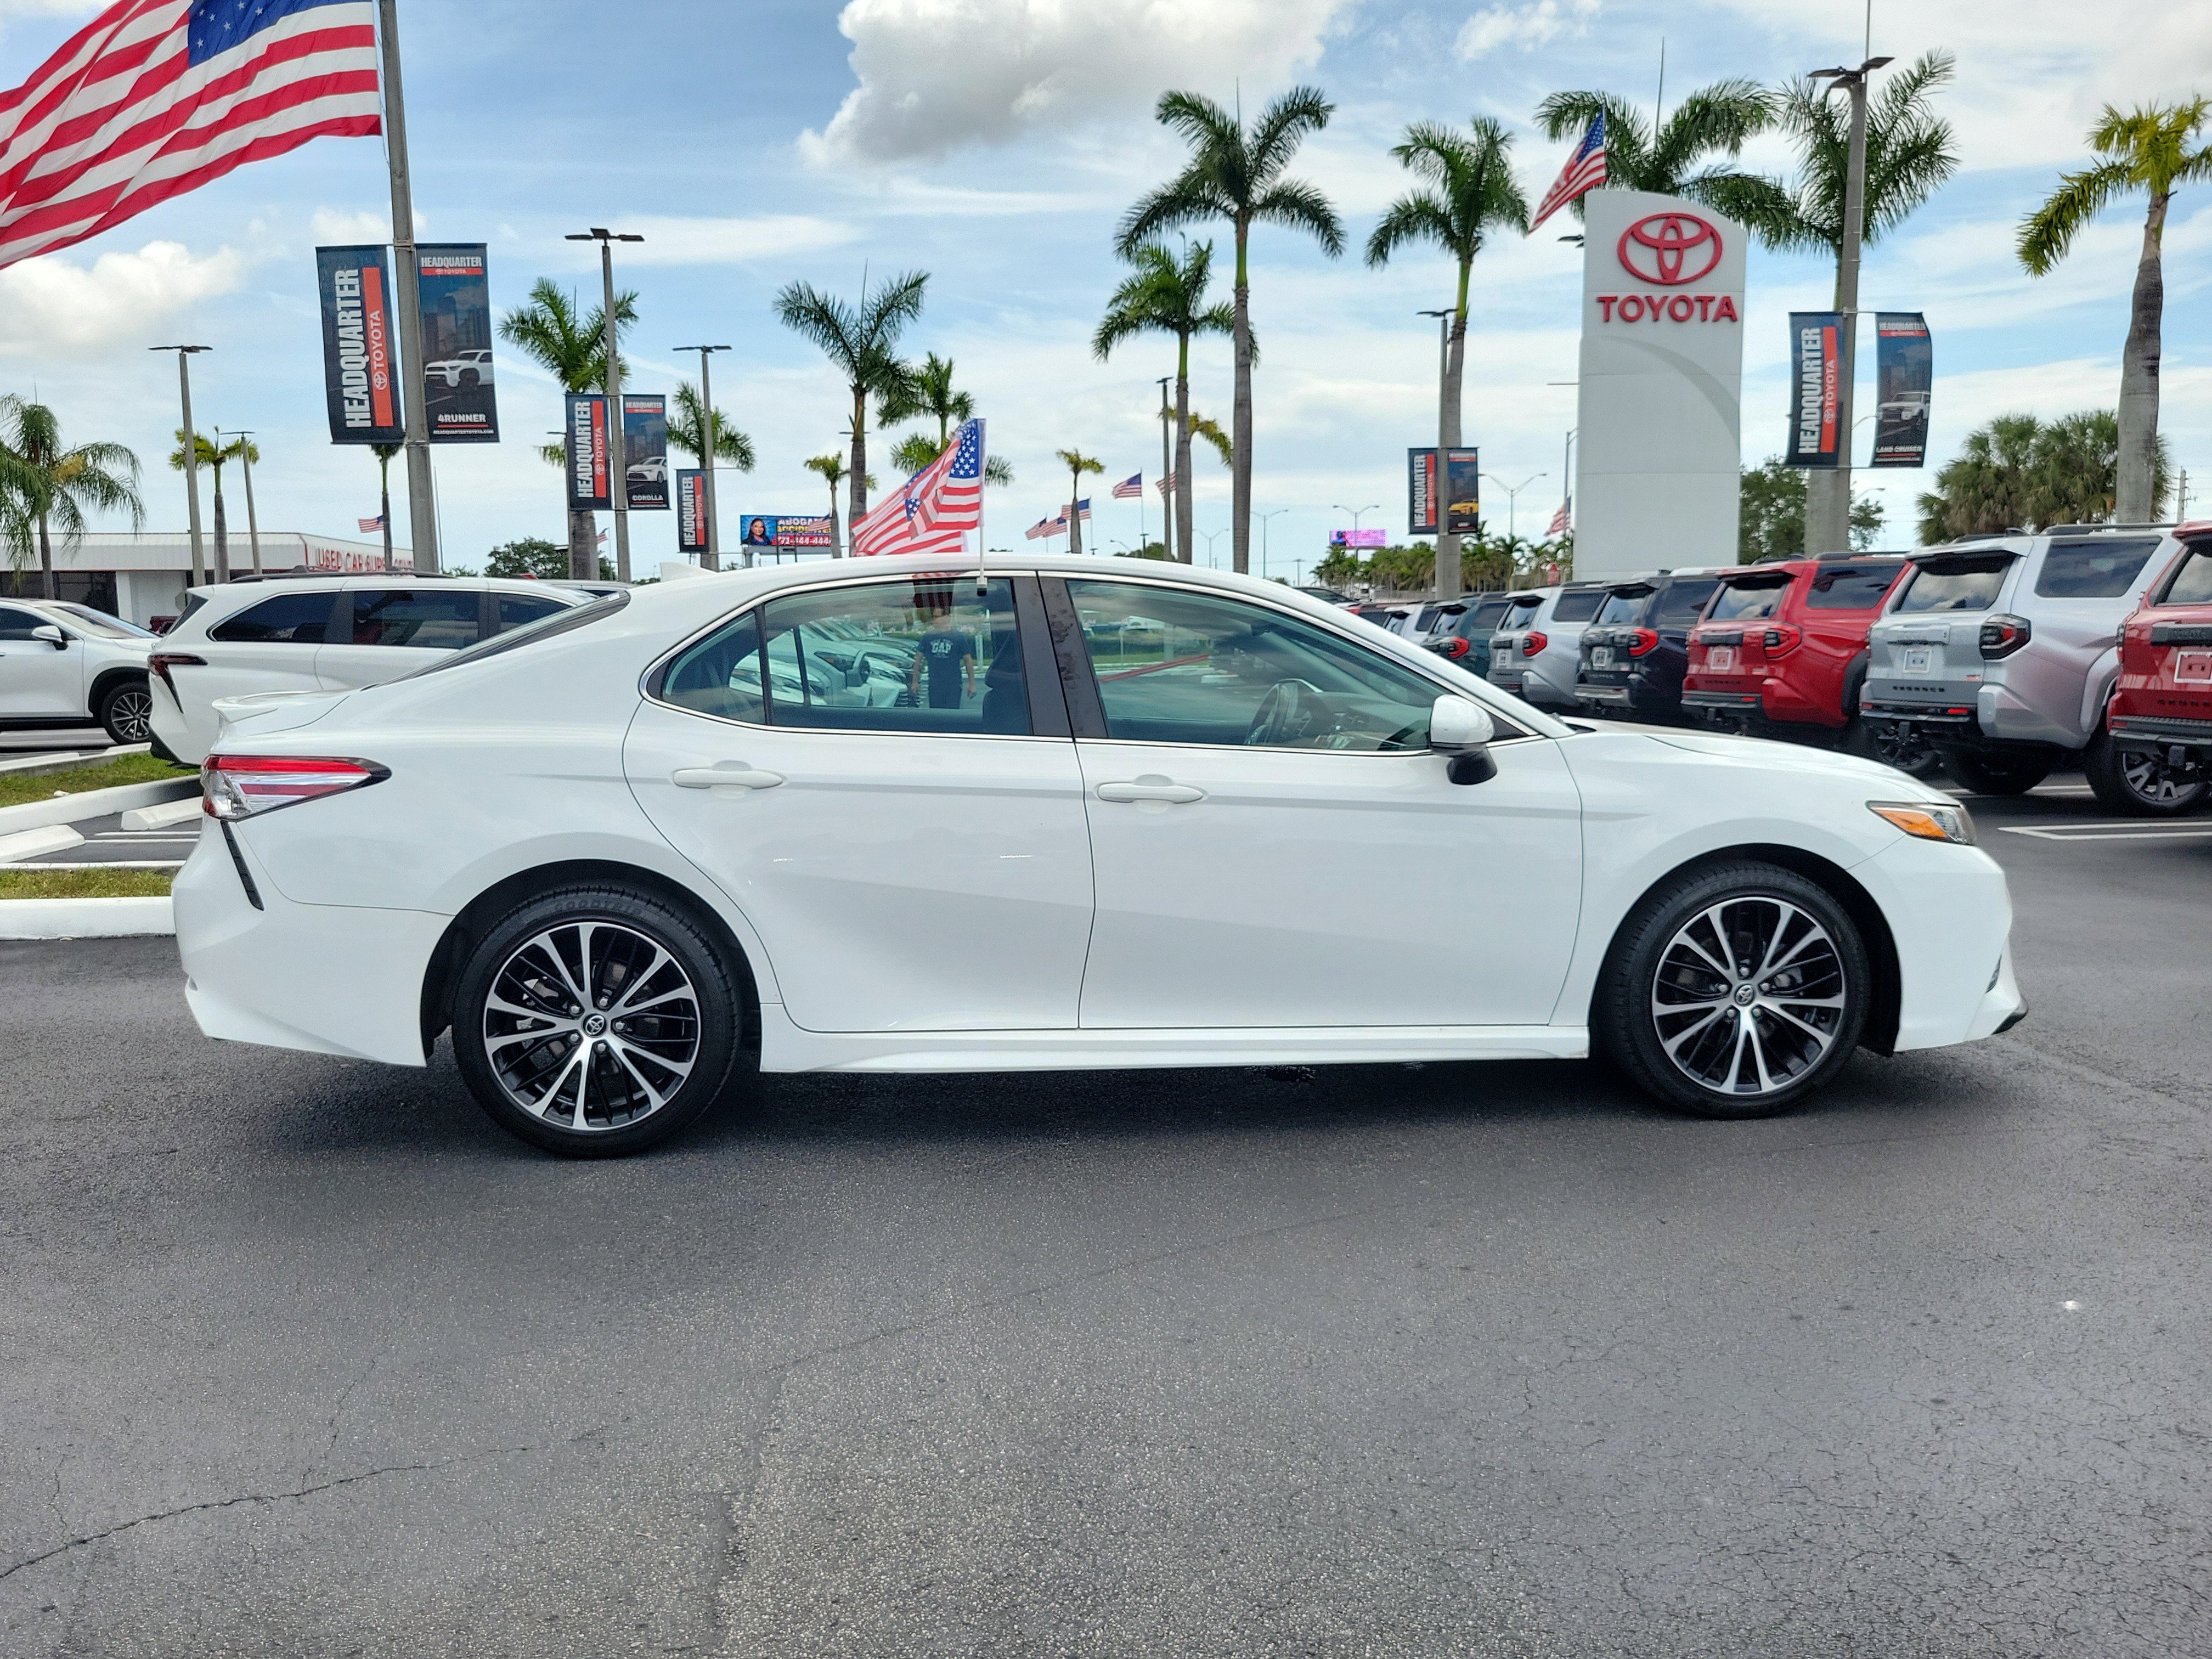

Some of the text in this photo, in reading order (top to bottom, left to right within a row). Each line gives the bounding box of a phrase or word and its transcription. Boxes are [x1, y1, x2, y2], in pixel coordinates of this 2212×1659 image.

[421, 257, 482, 268] HEADQUARTER
[1596, 295, 1738, 323] TOYOTA
[335, 269, 372, 428] HEADQUARTER
[370, 310, 387, 370] TOYOTA
[1798, 328, 1824, 454] HEADQUARTER
[1825, 359, 1836, 408] TOYOTA
[438, 413, 487, 423] 4RUNNER
[575, 401, 594, 498] HEADQUARTER
[594, 427, 605, 464] TOYOTA
[682, 476, 696, 545] HEADQUARTER
[696, 495, 704, 523] TOYOTA
[1414, 455, 1427, 527] HEADQUARTER
[318, 548, 342, 569] USED
[346, 552, 363, 572] CAR
[932, 642, 951, 653] GAP
